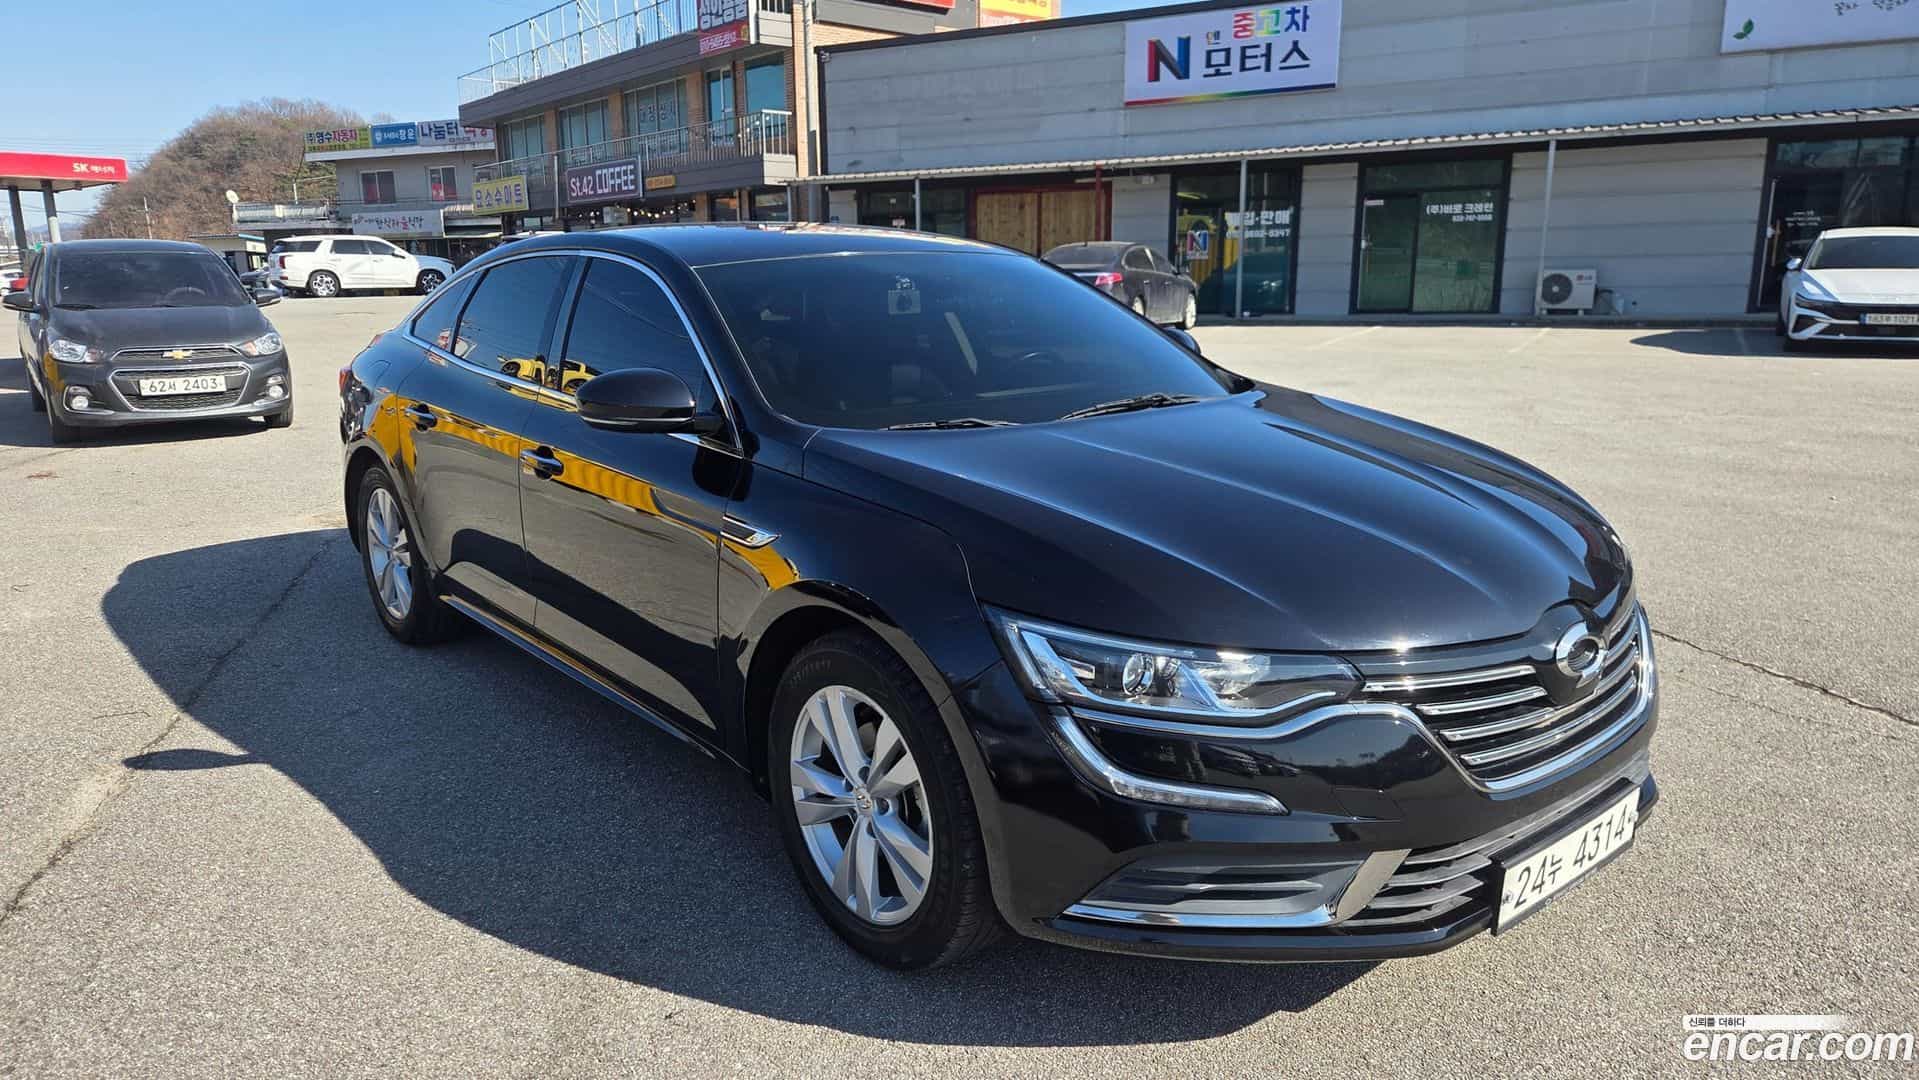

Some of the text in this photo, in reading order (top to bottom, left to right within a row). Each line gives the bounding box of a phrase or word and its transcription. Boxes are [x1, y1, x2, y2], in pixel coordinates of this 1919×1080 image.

[1233, 6, 1309, 40] 중고차
[1147, 36, 1310, 82] N 모터스
[420, 121, 458, 141] 나눔터
[72, 162, 89, 173] SK
[570, 174, 594, 197] St.42
[595, 164, 635, 194] COFFEE
[149, 378, 218, 393] 62서 2403
[1513, 803, 1628, 910] 24누 4314
